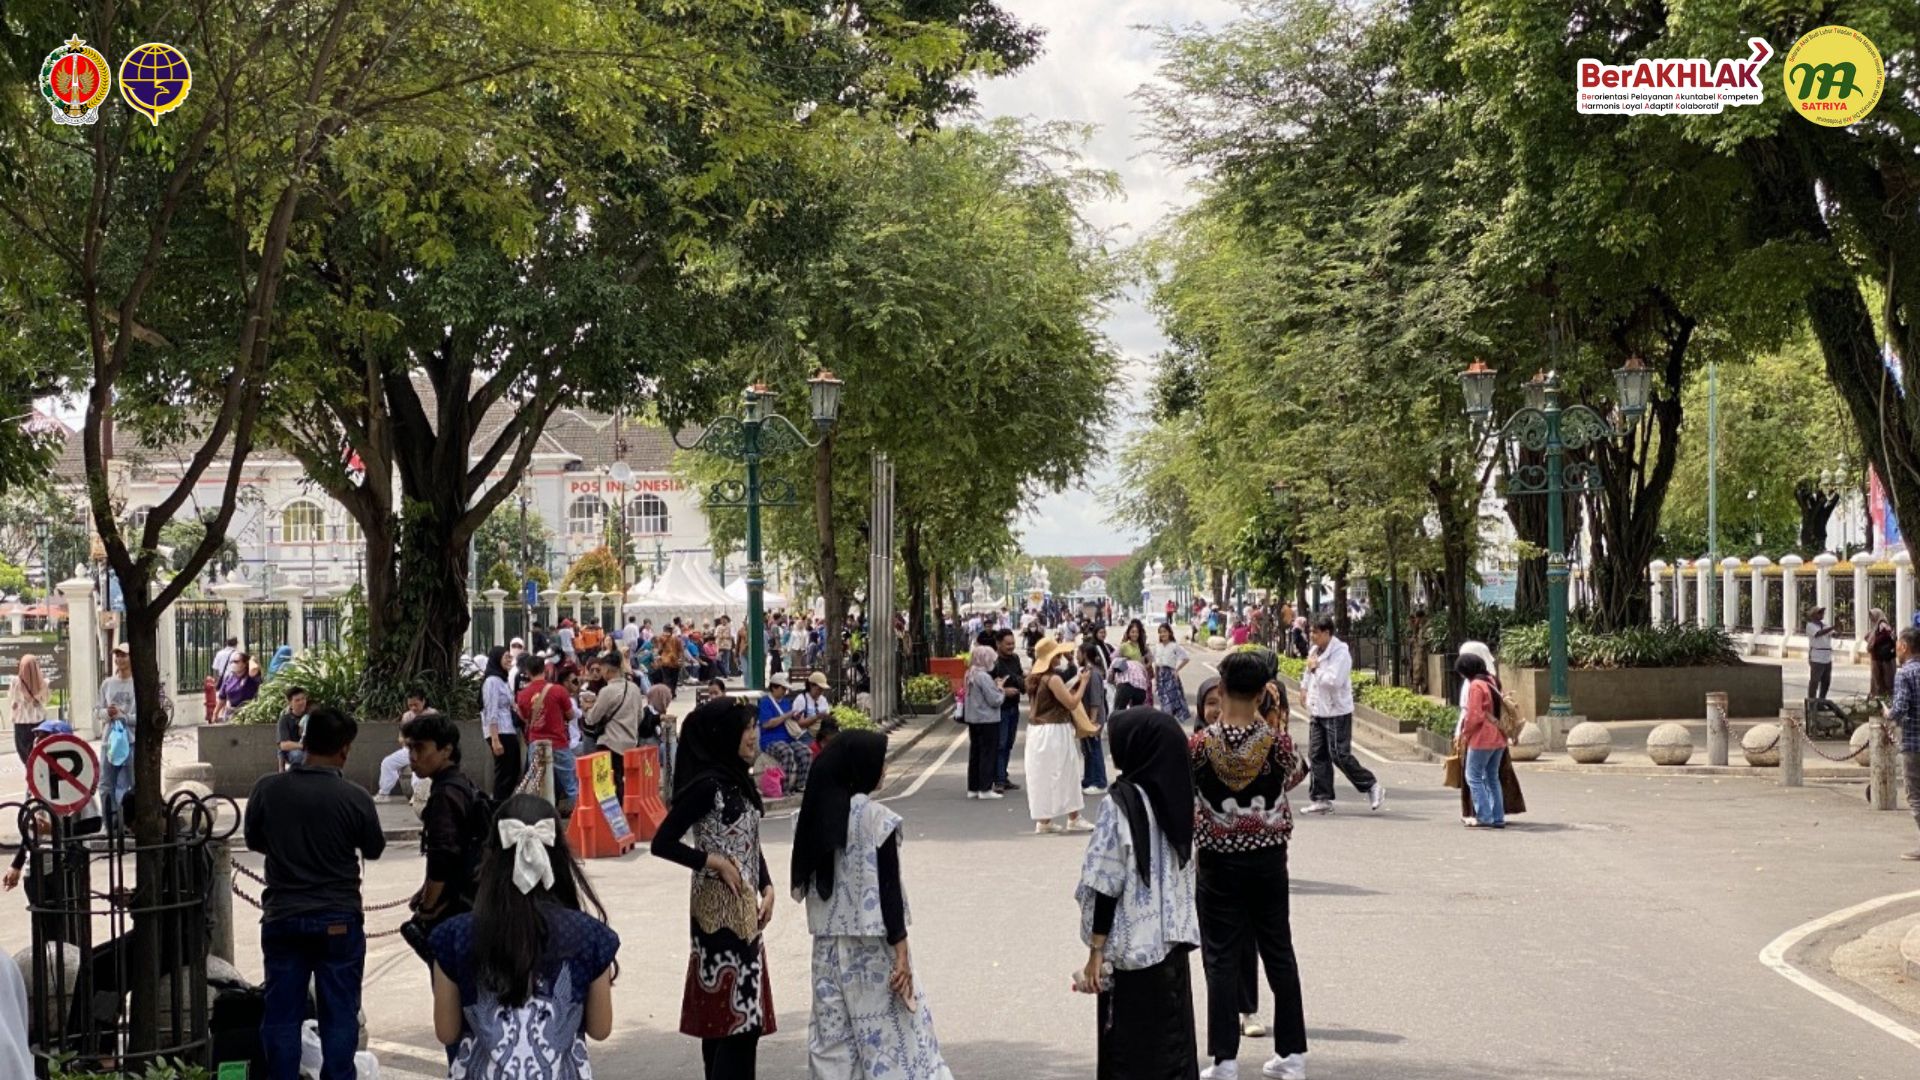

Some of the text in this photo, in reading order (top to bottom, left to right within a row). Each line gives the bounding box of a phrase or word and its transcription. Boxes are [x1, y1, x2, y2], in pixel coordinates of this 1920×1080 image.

[571, 479, 684, 493] POS INONESIA
[46, 750, 83, 800] P
